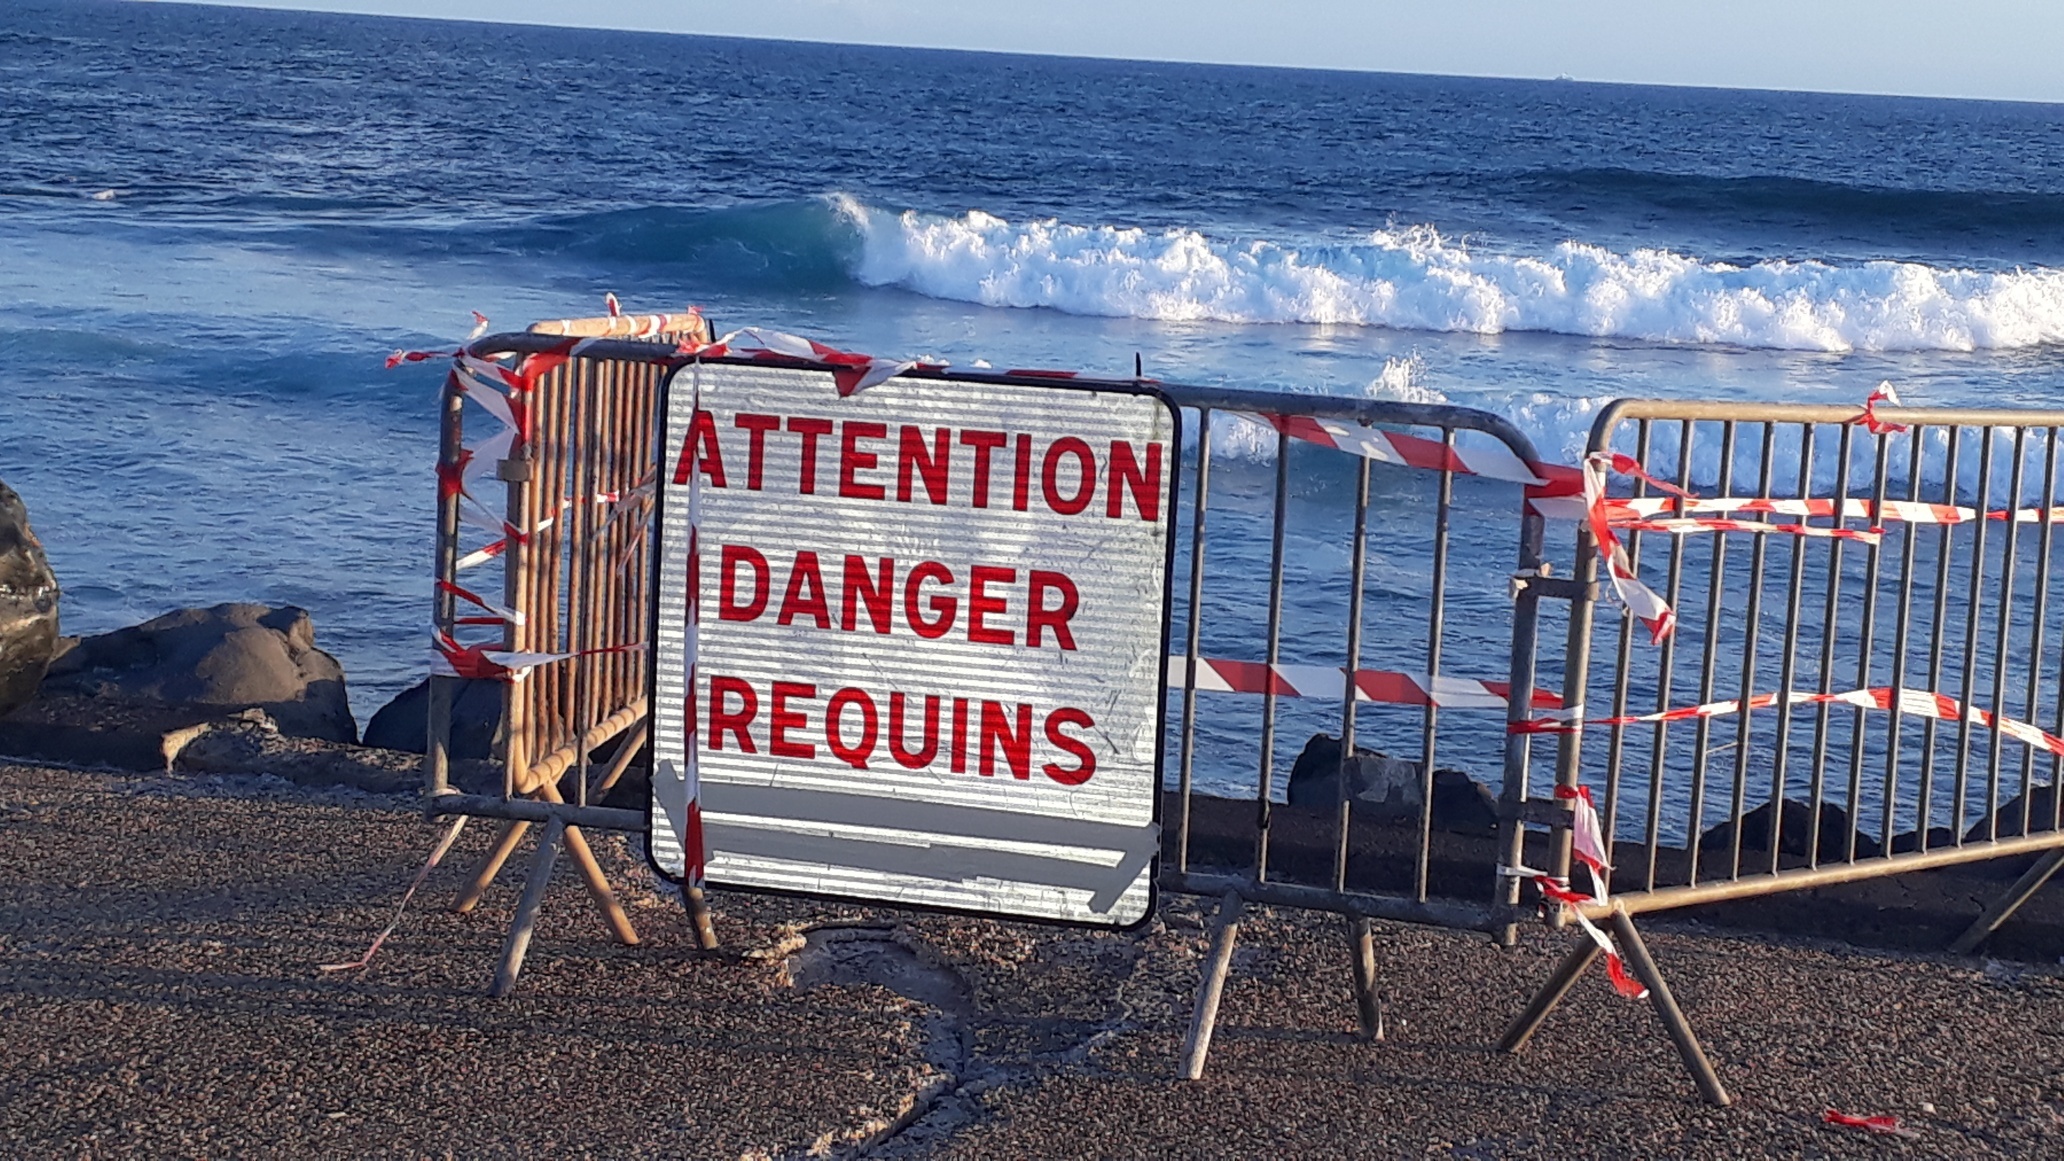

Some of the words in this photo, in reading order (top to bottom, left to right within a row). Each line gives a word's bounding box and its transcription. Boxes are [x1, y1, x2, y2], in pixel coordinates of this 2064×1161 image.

[672, 410, 1162, 522] ATTENTION
[718, 544, 1079, 651] DANGER
[707, 675, 1097, 787] REQUINS
